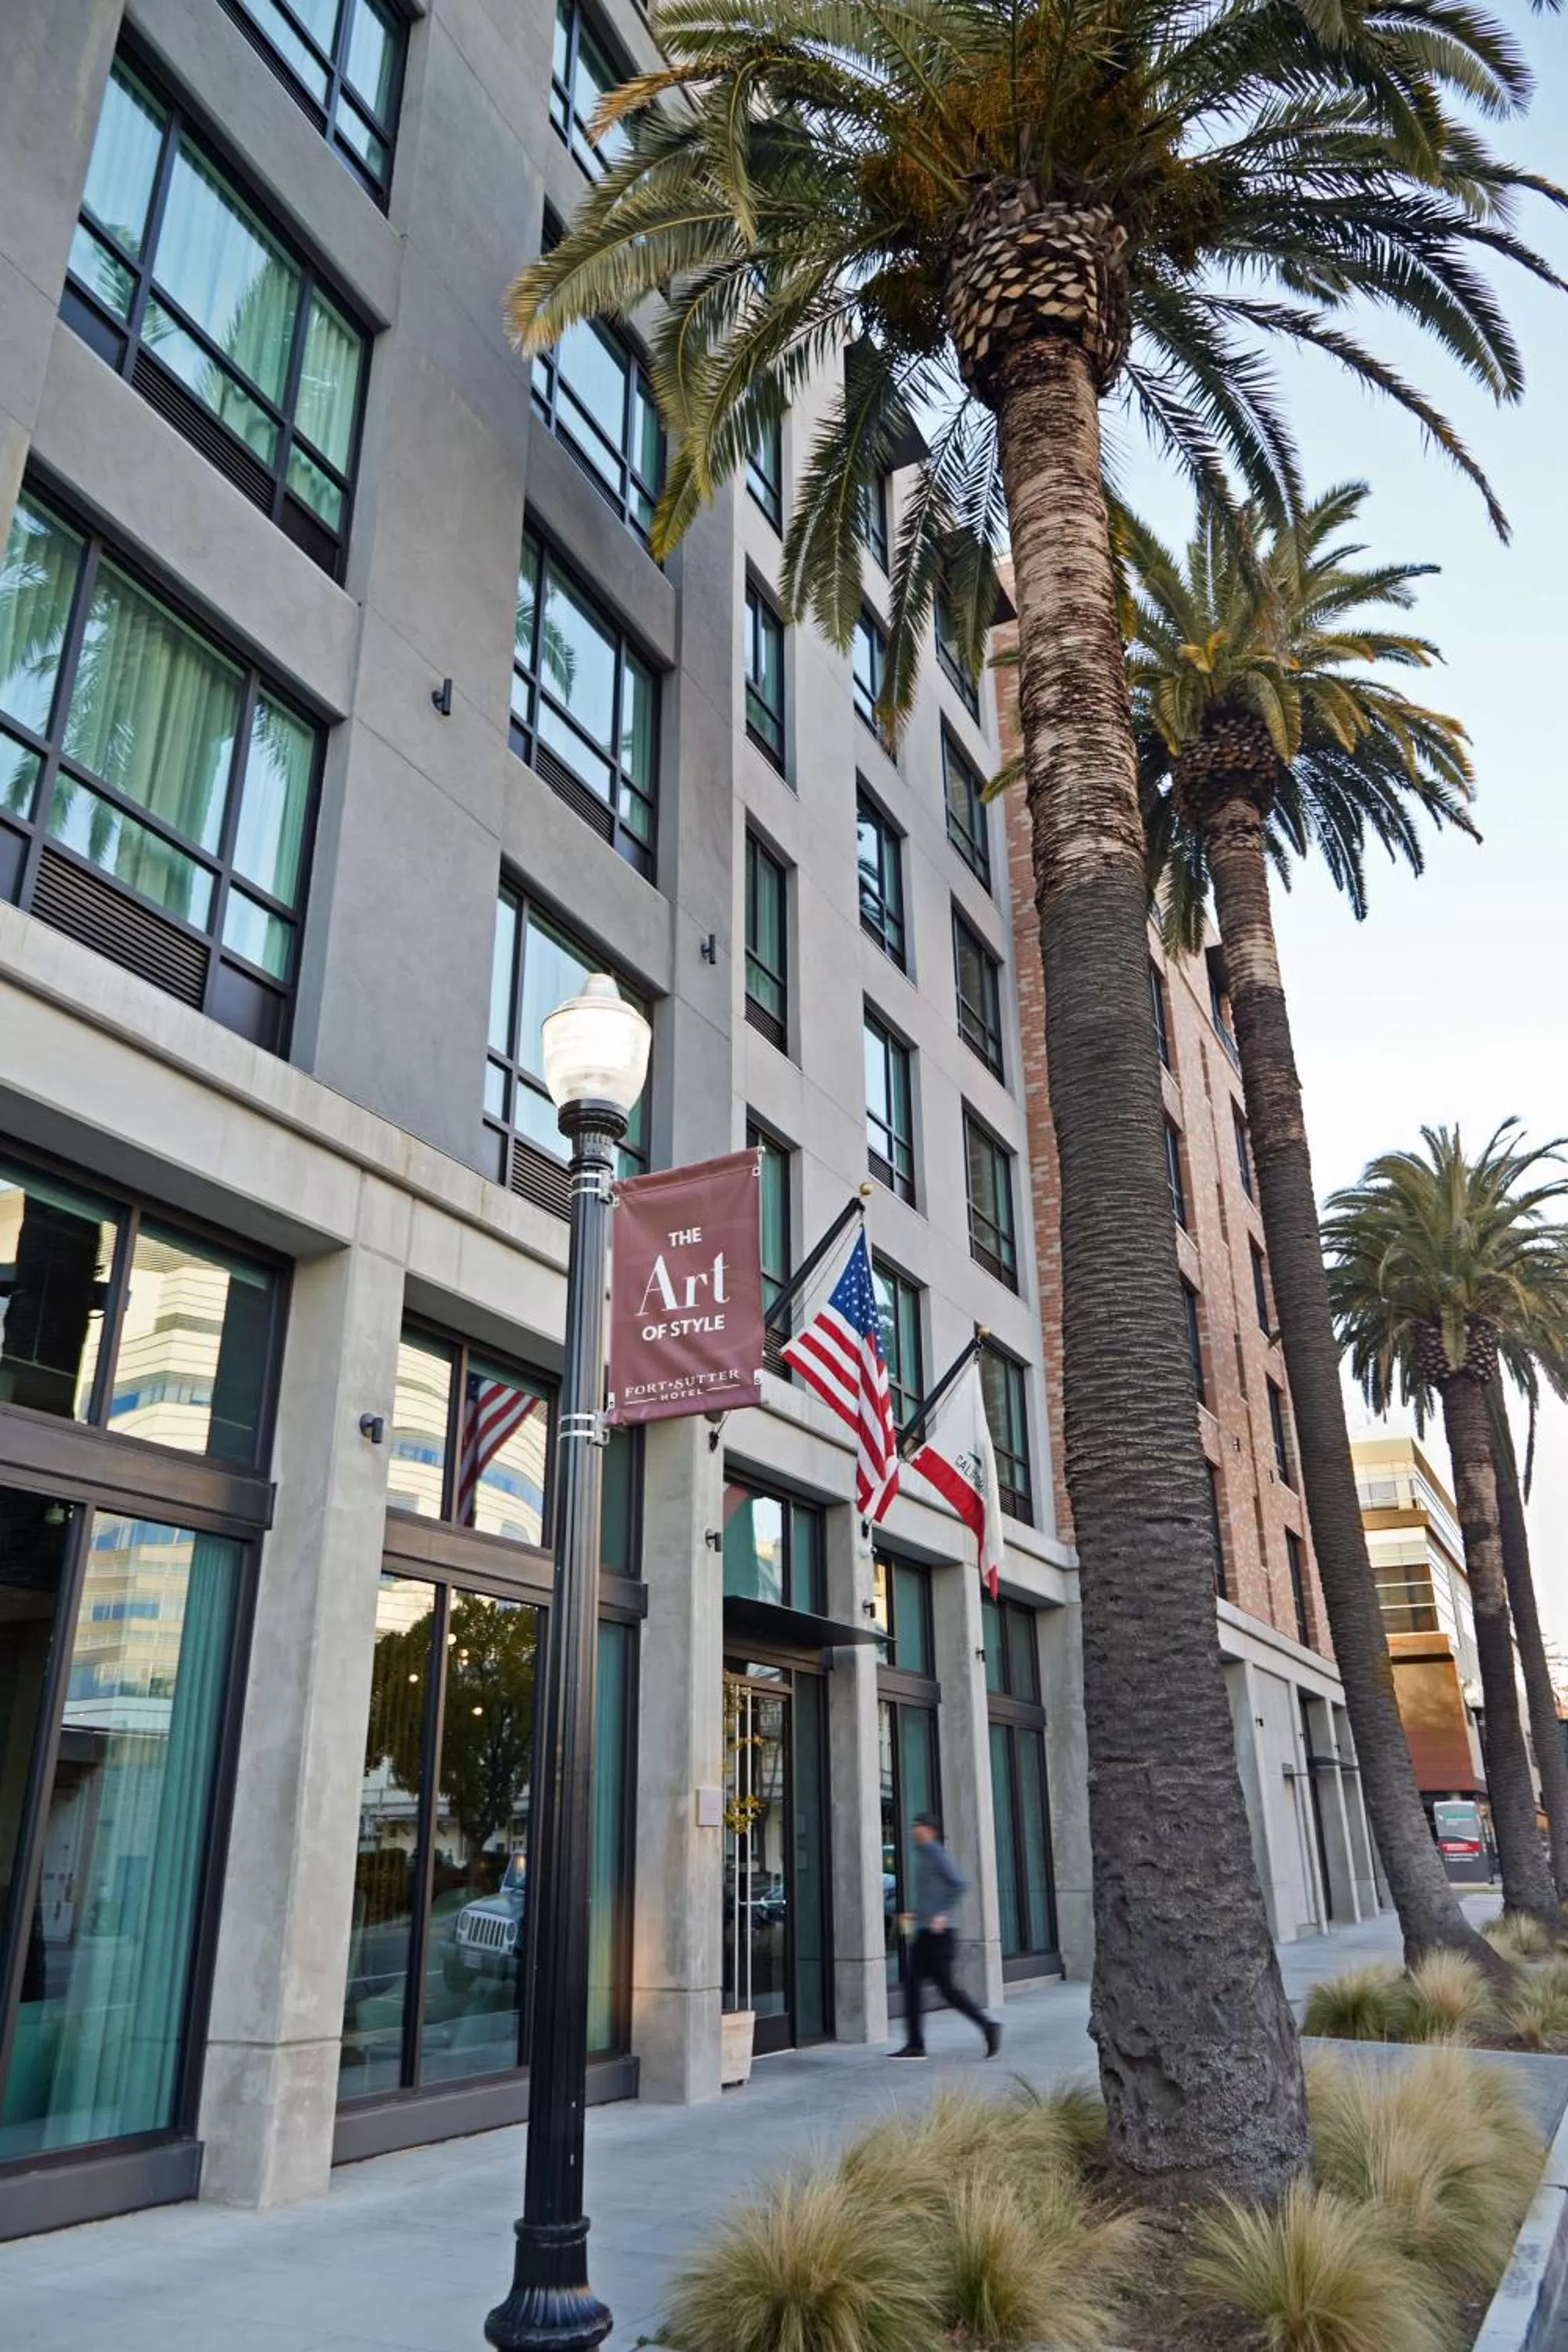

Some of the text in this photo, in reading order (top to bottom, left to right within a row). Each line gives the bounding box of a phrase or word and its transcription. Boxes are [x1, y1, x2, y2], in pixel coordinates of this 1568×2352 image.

[668, 1227, 702, 1247] THE
[634, 1252, 730, 1316] Art
[641, 1314, 725, 1341] OF STYLE
[661, 1388, 704, 1402] HOTEL
